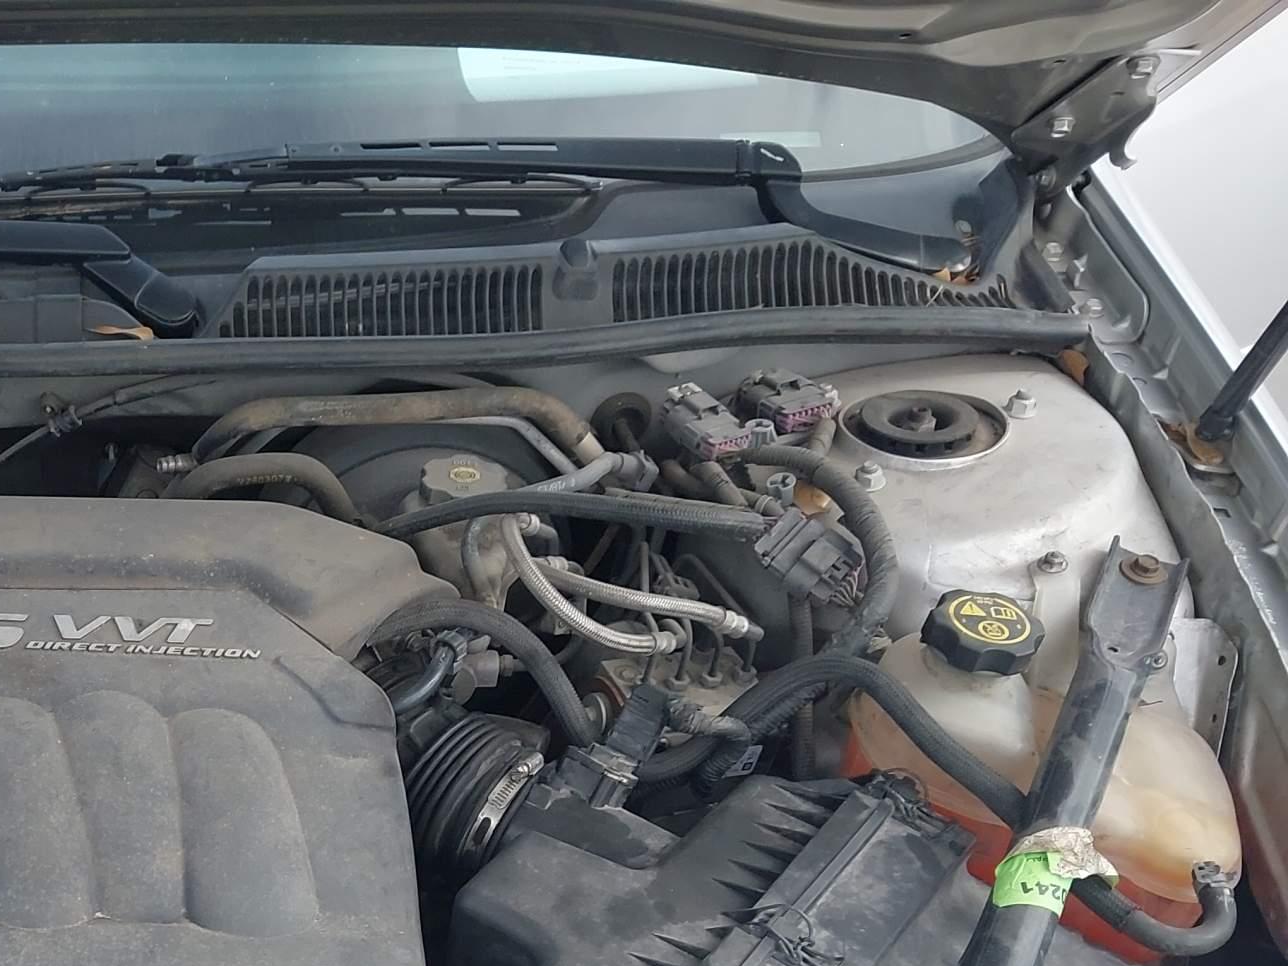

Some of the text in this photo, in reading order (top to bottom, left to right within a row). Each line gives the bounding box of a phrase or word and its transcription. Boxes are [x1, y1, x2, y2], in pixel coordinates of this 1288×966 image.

[52, 614, 214, 643] VVT
[25, 640, 262, 659] DIRECT INJECTION
